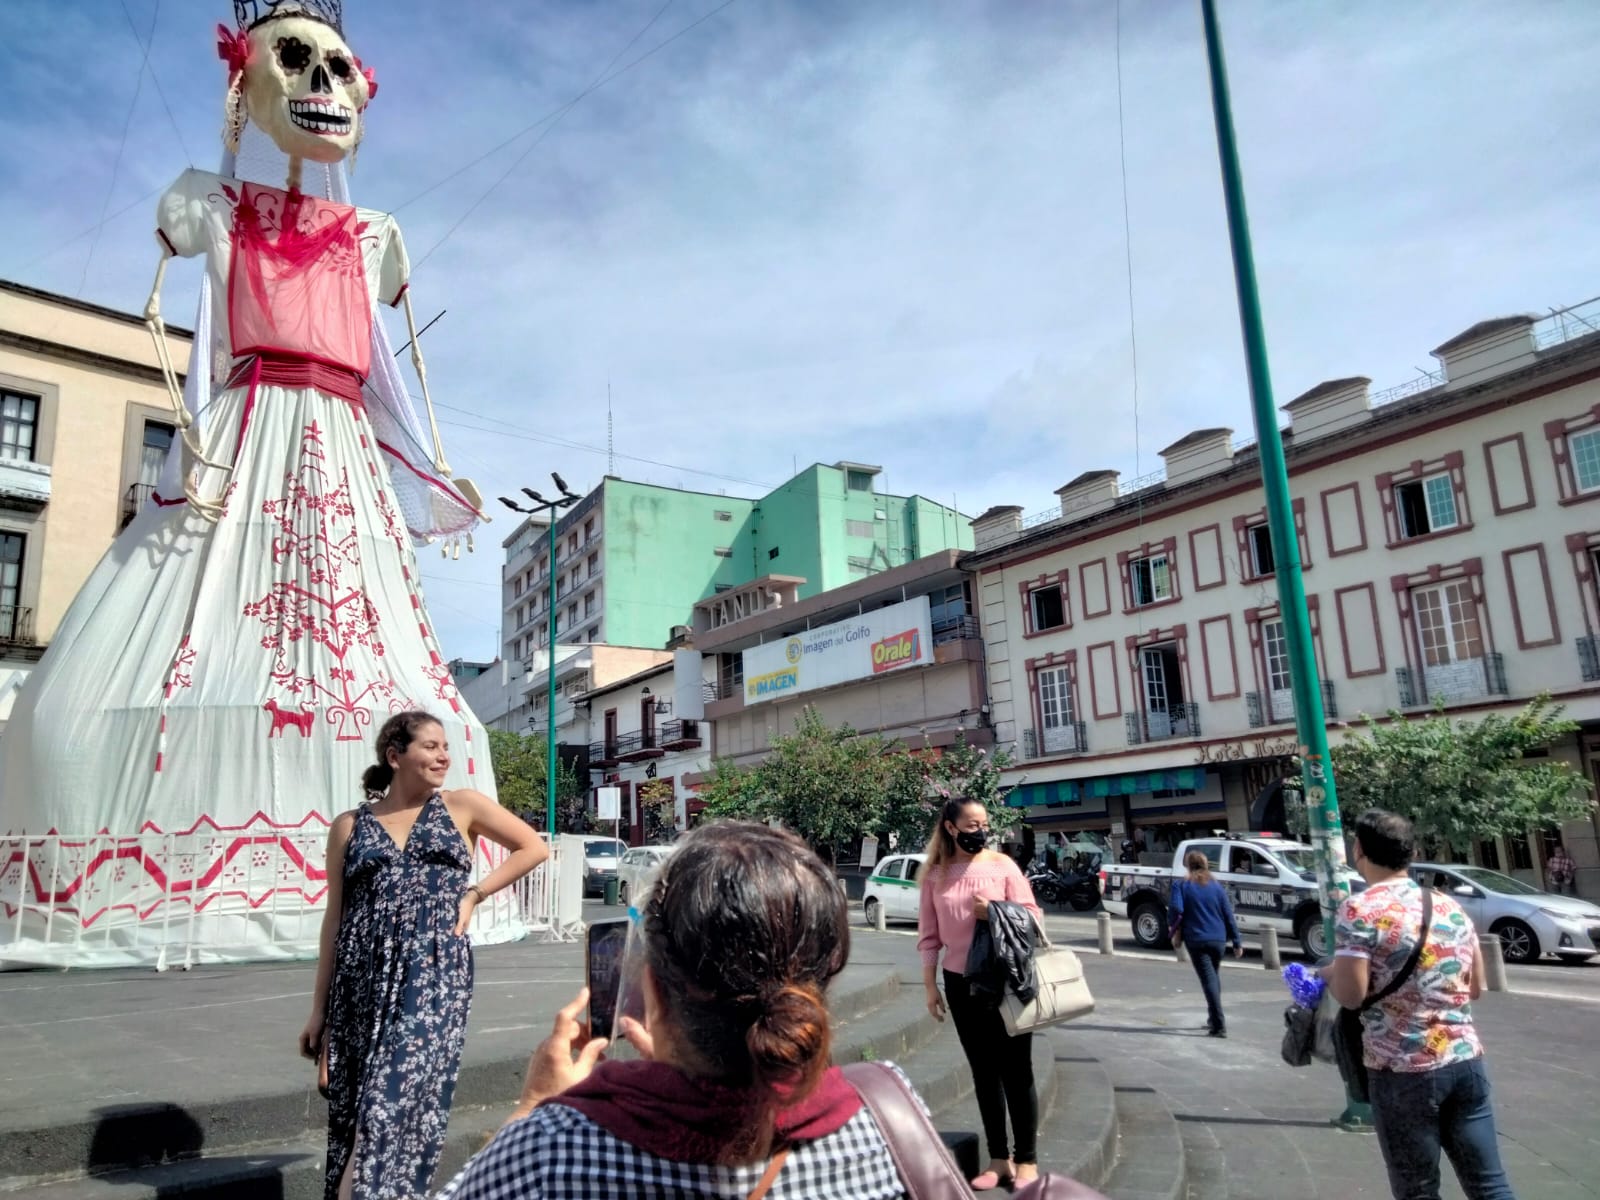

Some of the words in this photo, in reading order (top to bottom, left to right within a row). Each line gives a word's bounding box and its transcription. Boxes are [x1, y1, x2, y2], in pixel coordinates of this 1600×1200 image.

[803, 638, 833, 654] Imagen
[846, 626, 871, 642] Golfo
[756, 671, 797, 696] IMAGEN
[1194, 742, 1248, 764] Hotel
[1239, 888, 1277, 908] MUNICIPAL
